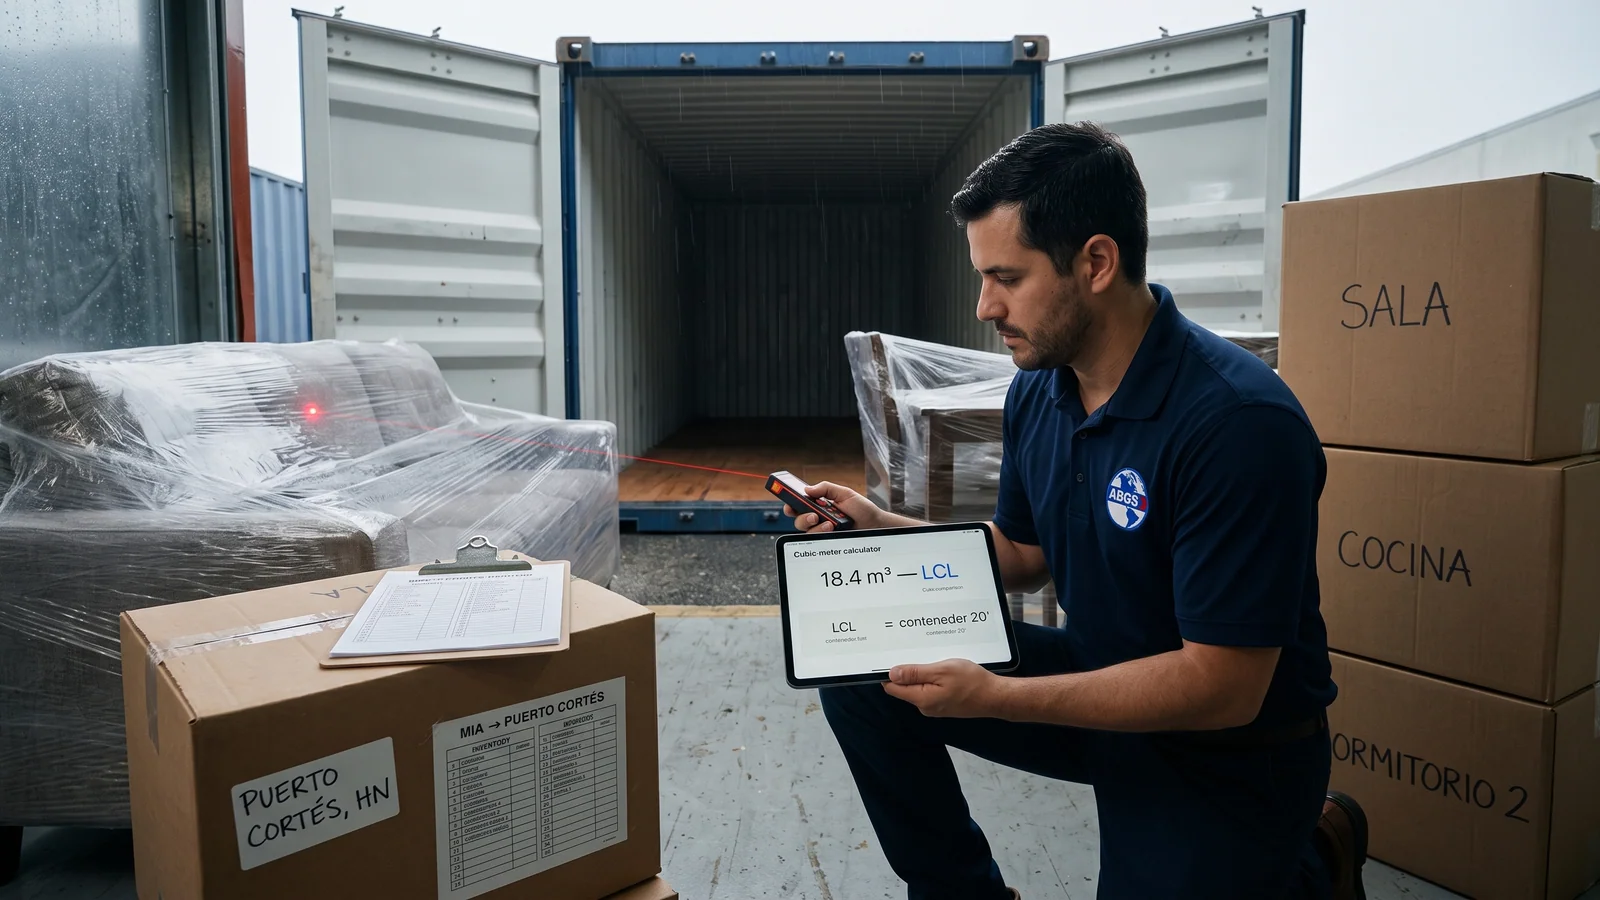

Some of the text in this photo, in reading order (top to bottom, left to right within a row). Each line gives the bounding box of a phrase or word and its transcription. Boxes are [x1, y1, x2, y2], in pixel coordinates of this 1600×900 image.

[1341, 281, 1451, 329] SALA
[1109, 488, 1139, 507] ABGS
[843, 546, 882, 555] calculator
[1338, 530, 1472, 587] COCINA
[820, 570, 862, 588] 18.4
[922, 563, 959, 580] LCL
[832, 621, 857, 632] LCL
[899, 614, 968, 628] conteneder
[460, 690, 605, 739] MIA PUERTO CORTÉS
[239, 768, 338, 816] PUERTO
[1332, 732, 1530, 824] ORMITORIO 2
[247, 776, 390, 848] CORTÉS, HN
